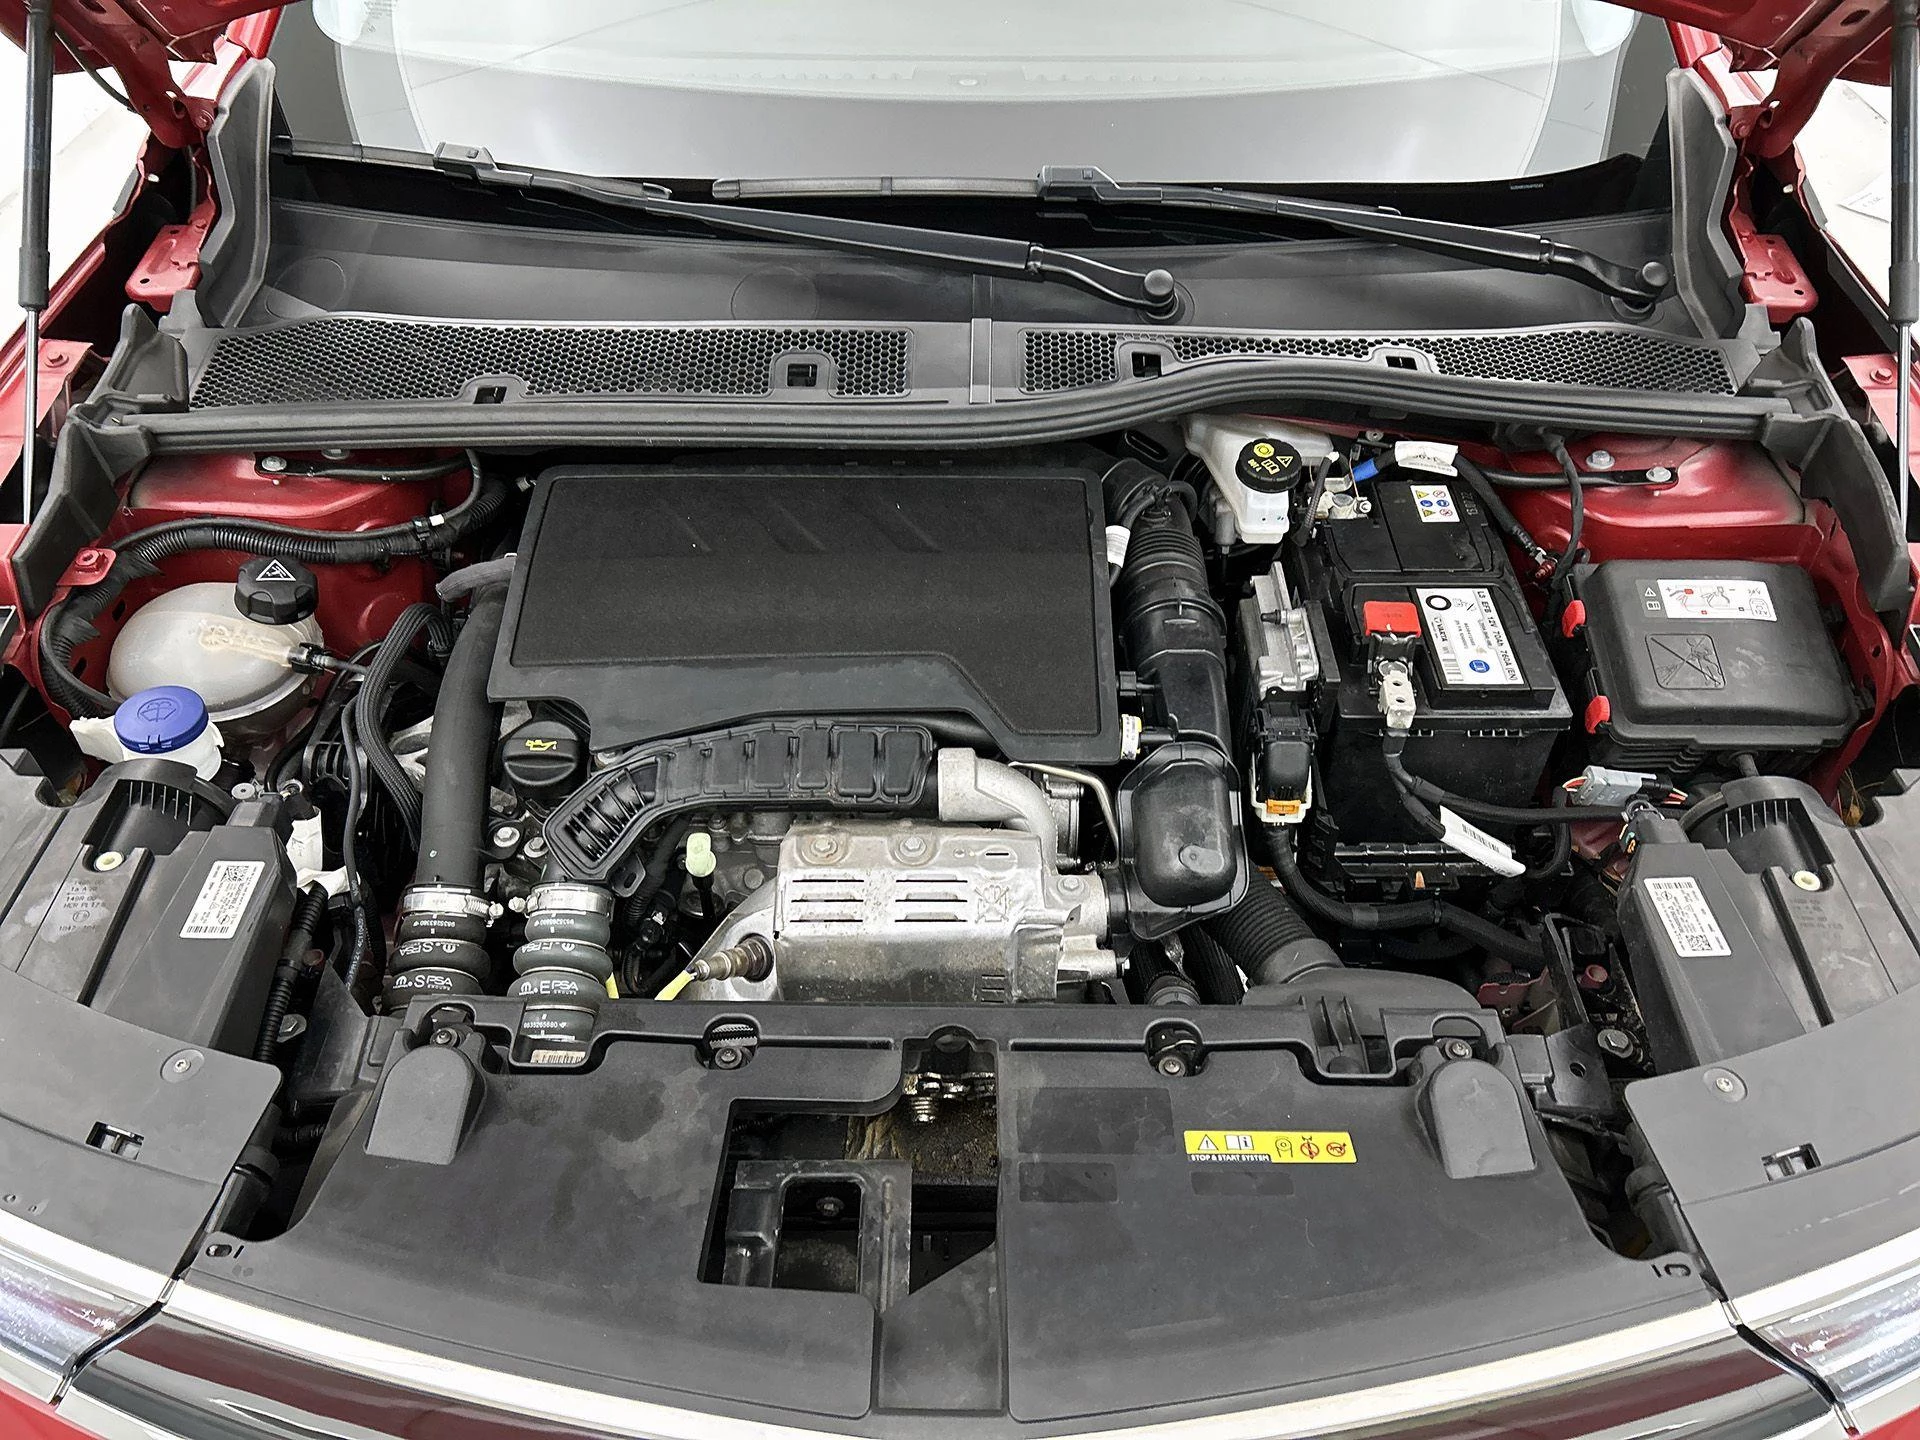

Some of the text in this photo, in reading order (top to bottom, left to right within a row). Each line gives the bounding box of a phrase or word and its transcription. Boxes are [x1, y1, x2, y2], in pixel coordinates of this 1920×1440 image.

[1488, 616, 1498, 628] 12V
[1437, 624, 1448, 641] VARTA
[413, 974, 453, 988] S PSA
[540, 980, 551, 995] E
[551, 980, 579, 991] PSA
[1190, 1154, 1270, 1162] STOP & START SYSTEM
